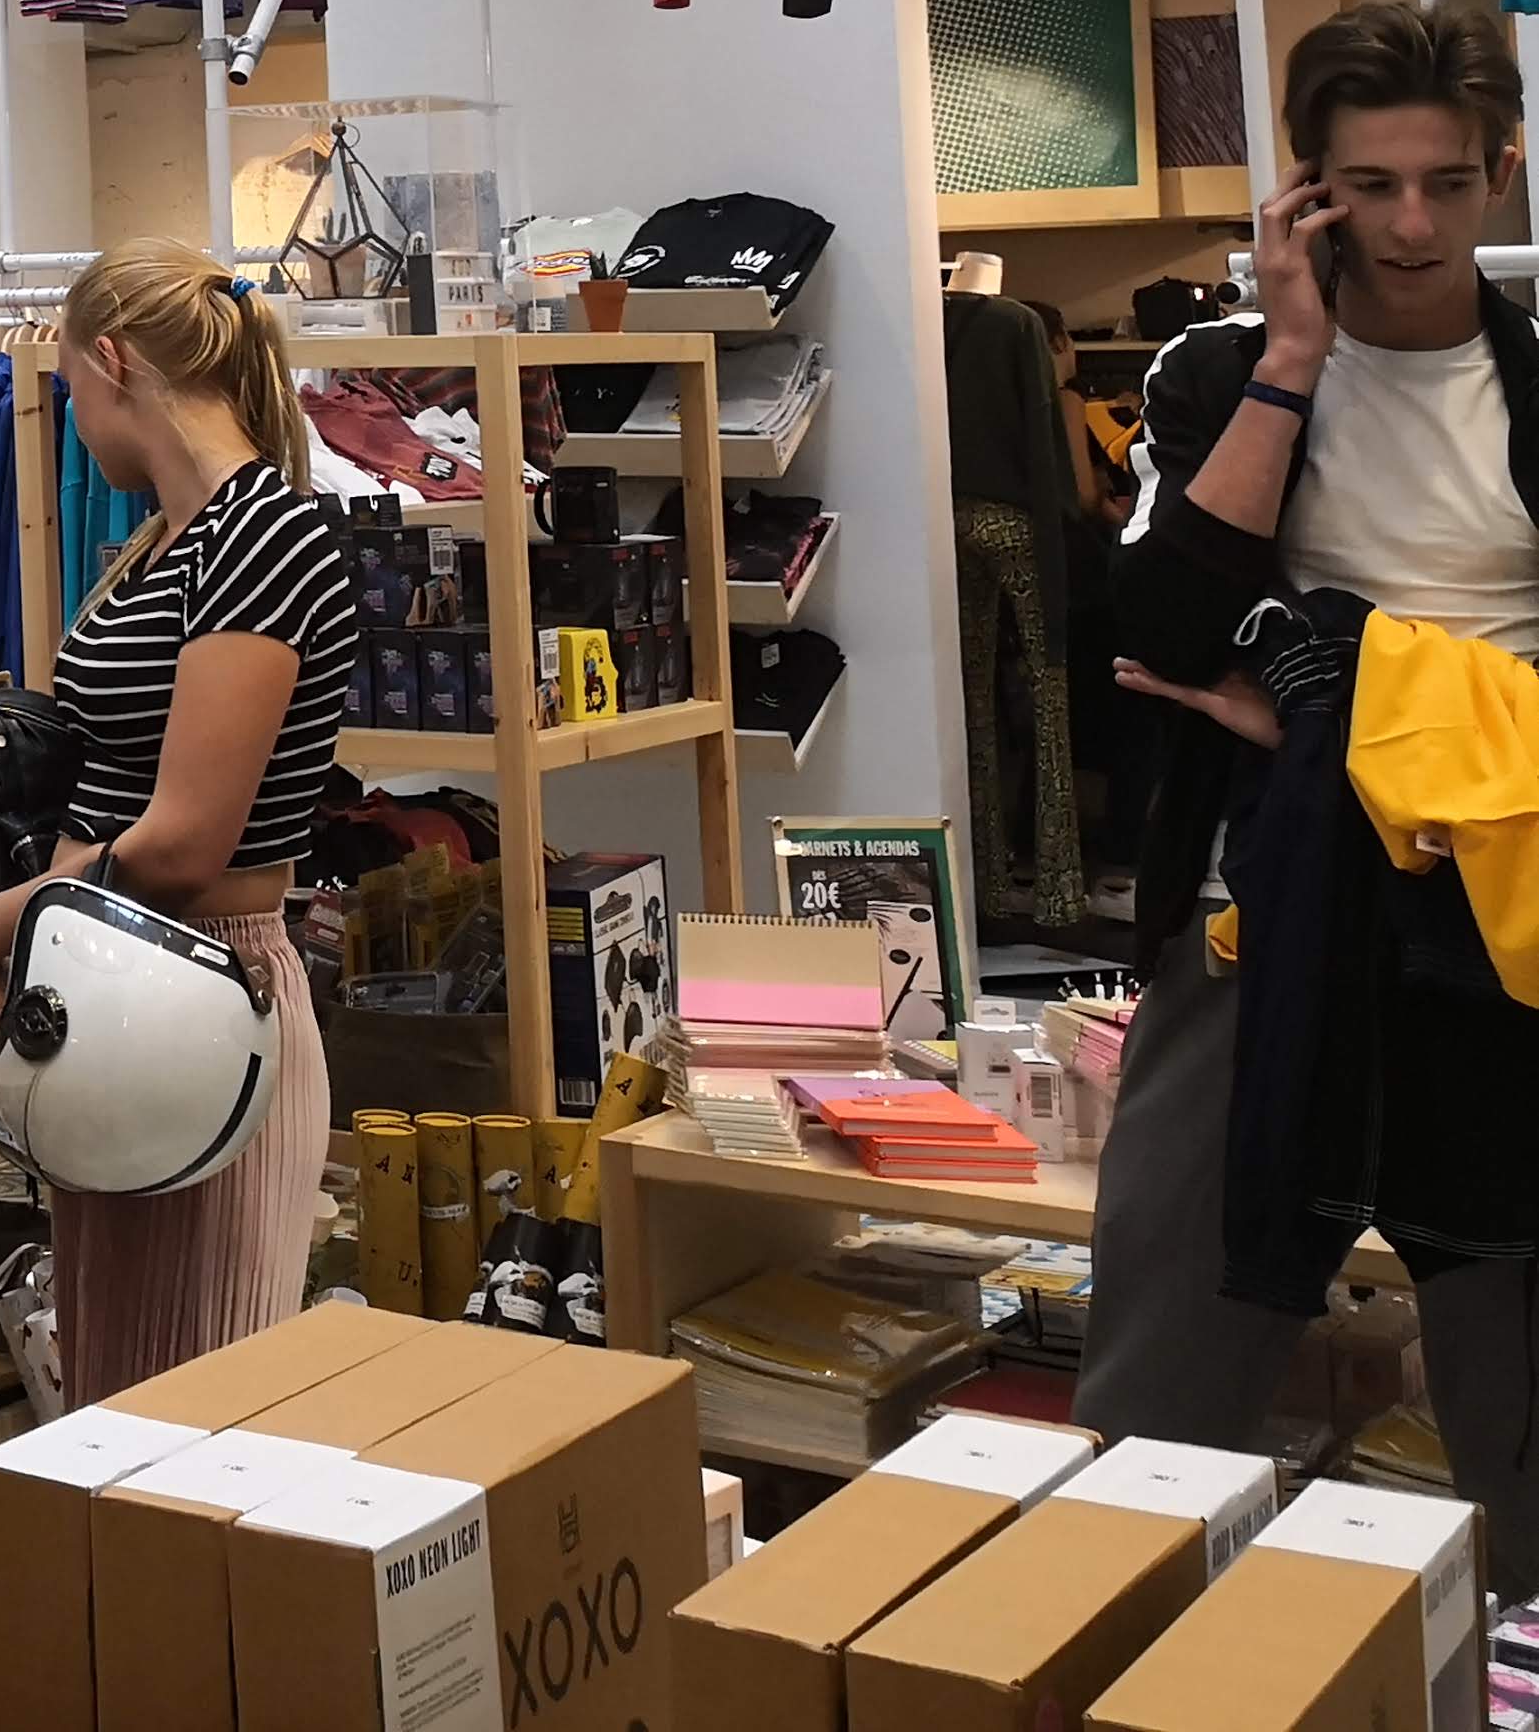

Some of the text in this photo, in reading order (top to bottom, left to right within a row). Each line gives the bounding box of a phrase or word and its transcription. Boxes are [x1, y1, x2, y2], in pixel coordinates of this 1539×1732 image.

[866, 840, 920, 857] AGENDAS
[801, 882, 842, 909] 20€
[385, 1518, 481, 1599] XOXO NEON LIGHT
[504, 1556, 643, 1731] XOXO
